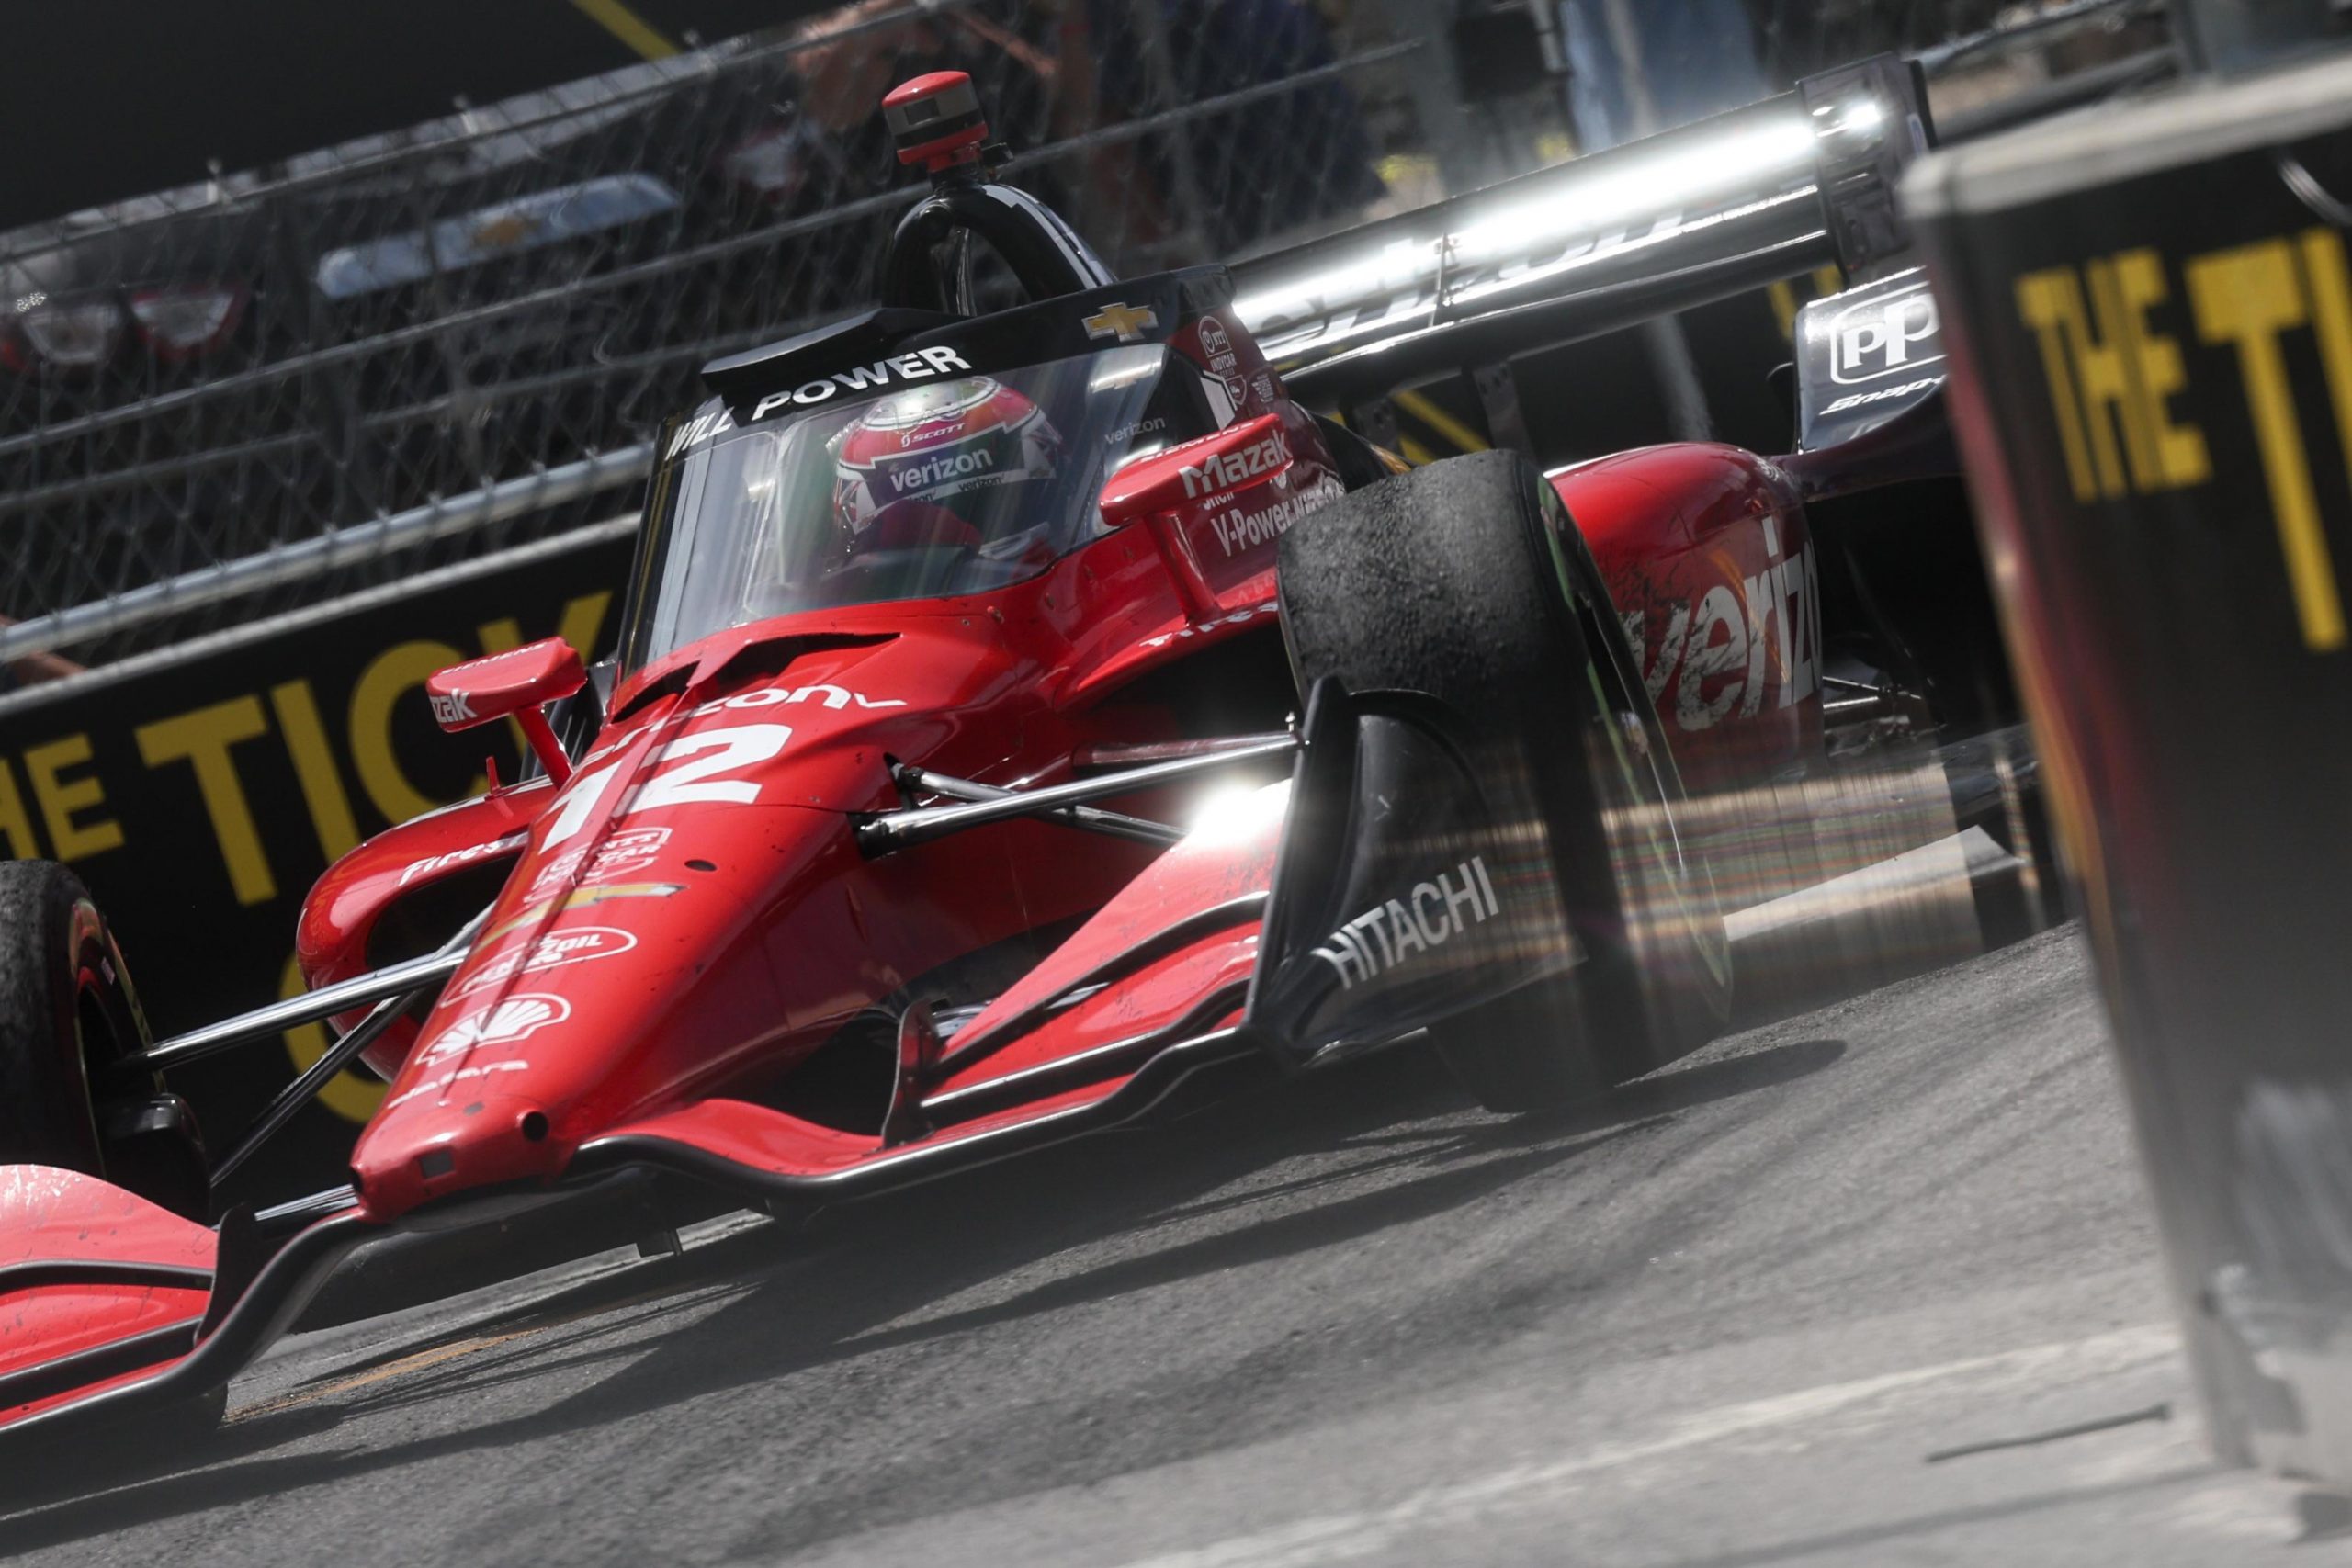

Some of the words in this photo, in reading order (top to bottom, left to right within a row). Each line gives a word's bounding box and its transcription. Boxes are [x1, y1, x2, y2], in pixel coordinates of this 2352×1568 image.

[664, 406, 734, 461] WILL
[752, 345, 972, 421] POWER
[2018, 250, 2211, 503] THE
[911, 422, 966, 443] SCOTT
[1104, 416, 1167, 446] verizon
[1179, 428, 1293, 500] Mazak
[890, 448, 994, 492] verizon
[1210, 500, 1292, 557] V-Power
[538, 723, 793, 855] 12
[1309, 855, 1499, 990] HITACHI
